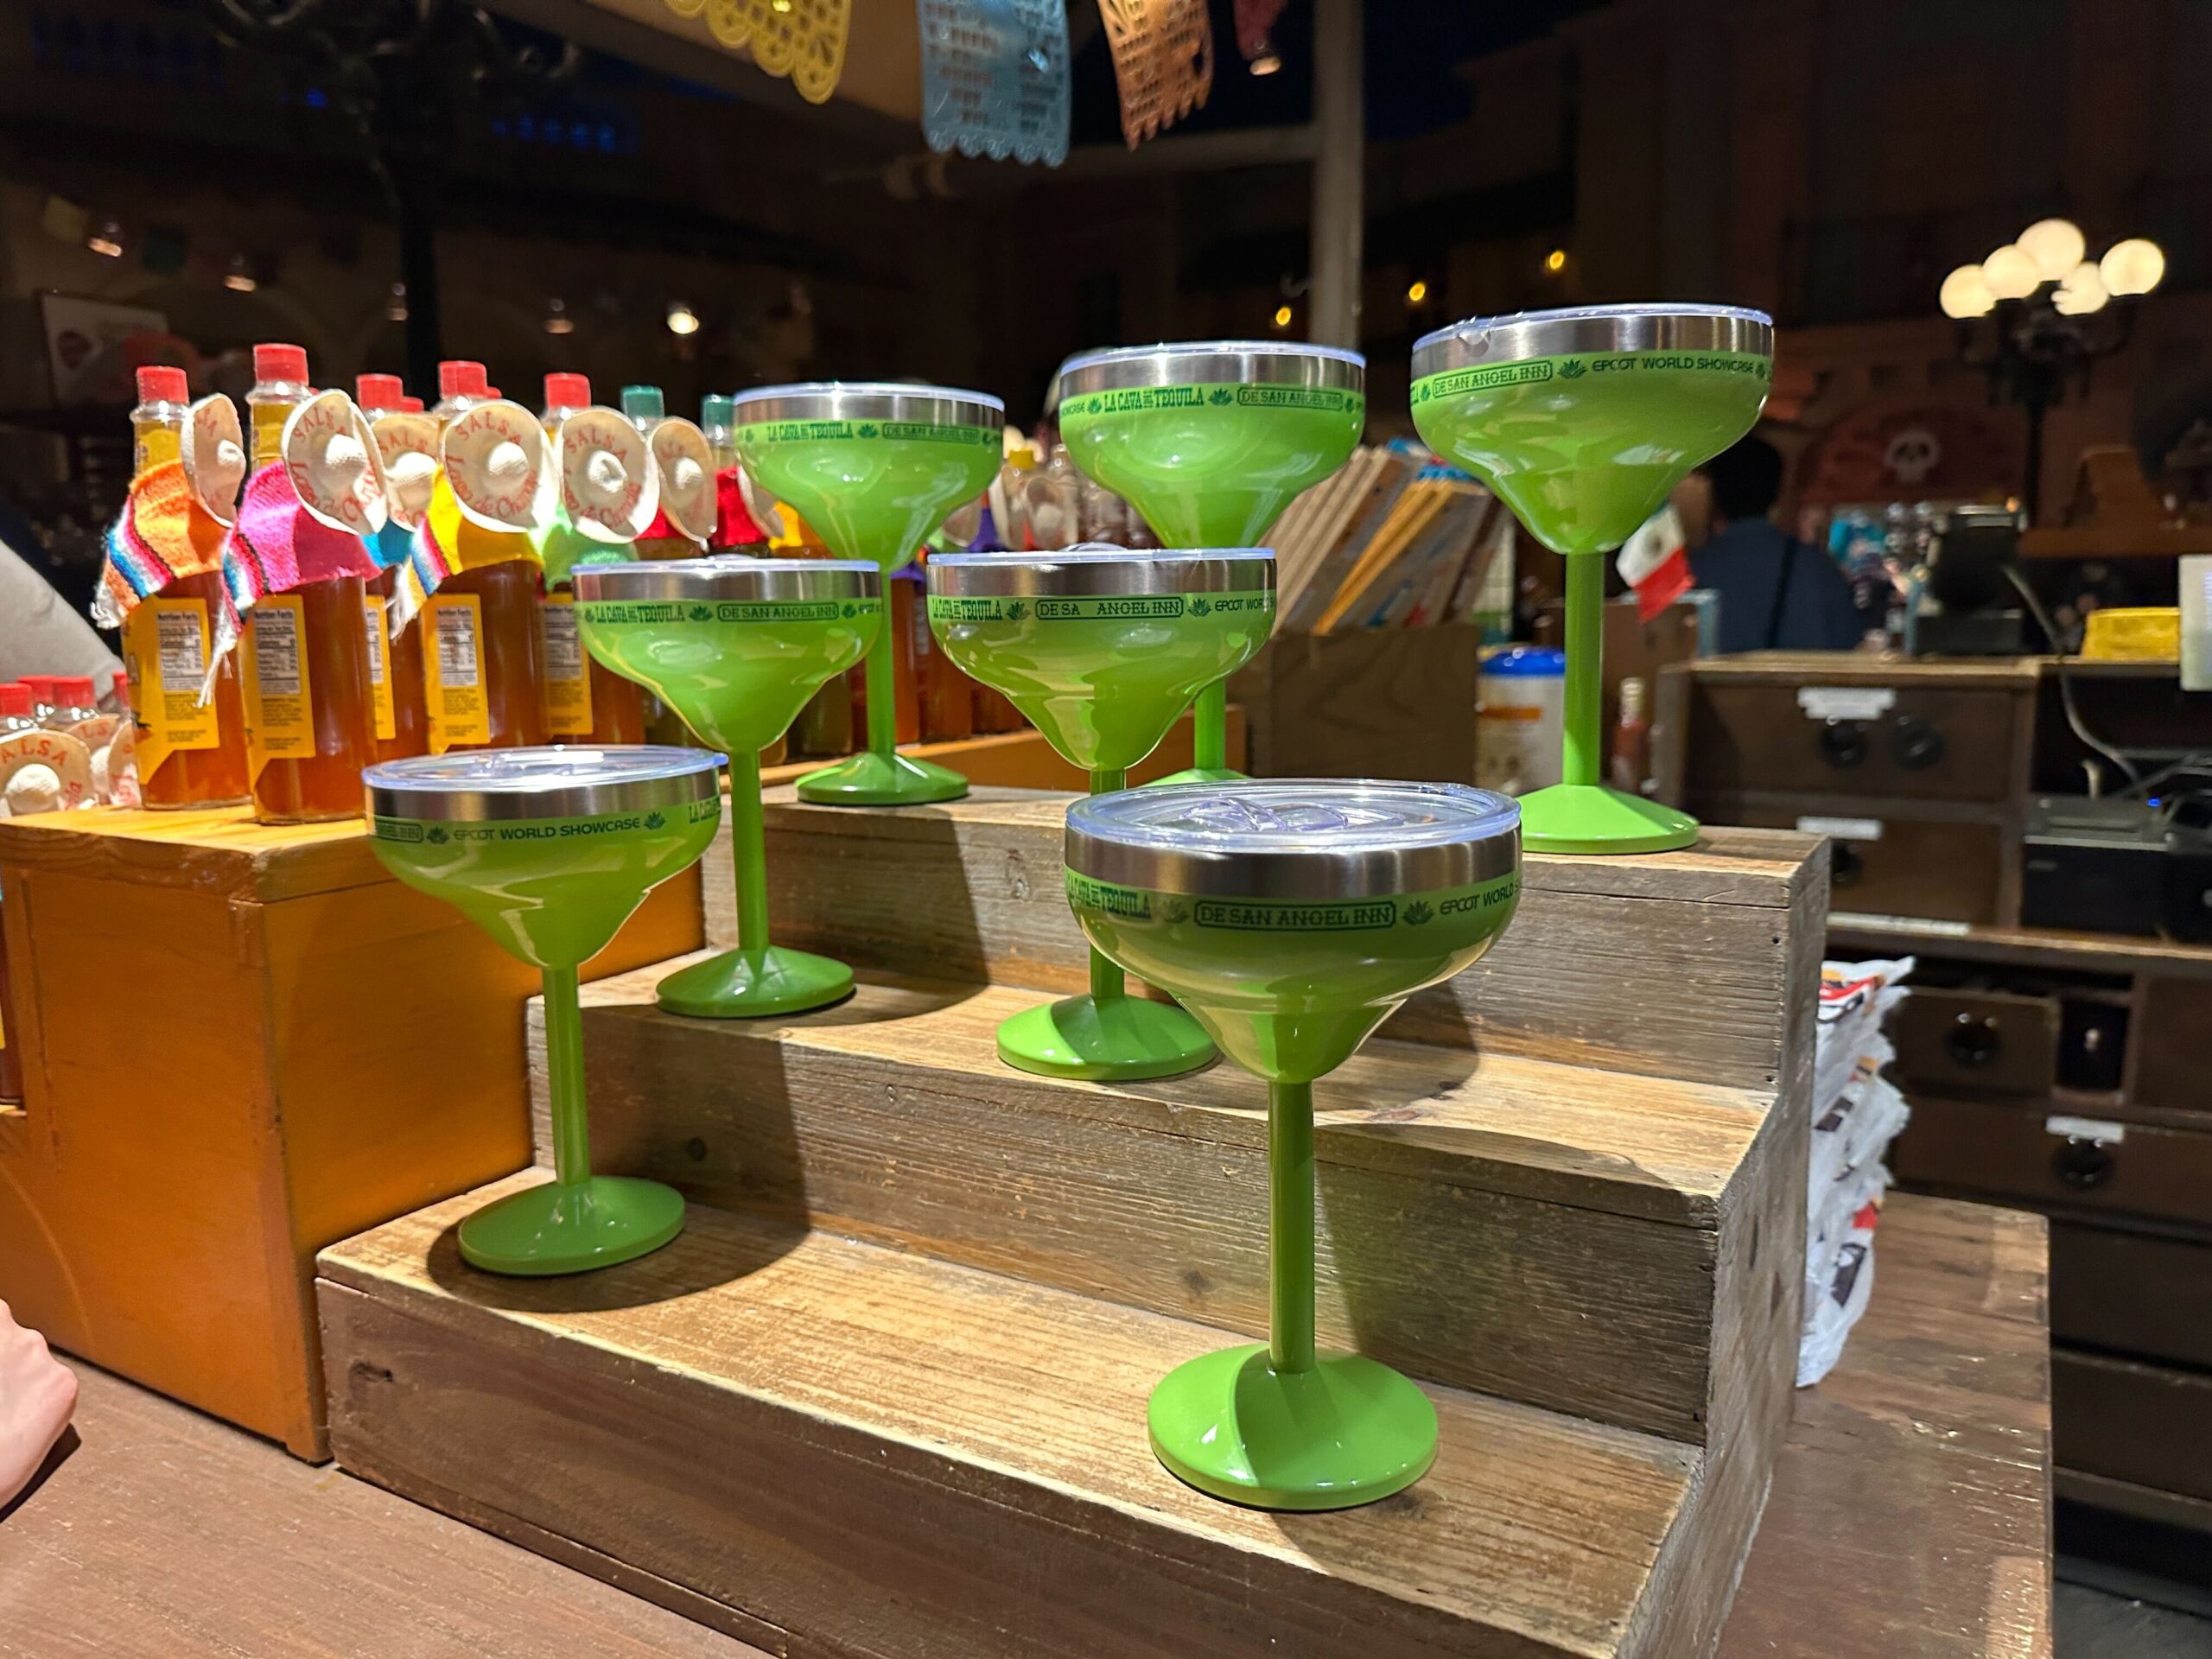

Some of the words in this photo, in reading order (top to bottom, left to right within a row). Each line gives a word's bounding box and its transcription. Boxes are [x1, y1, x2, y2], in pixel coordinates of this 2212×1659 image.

[1592, 358, 1637, 372] EPCOT
[1642, 357, 1694, 370] WORLD
[1697, 358, 1754, 374] SHOWCASE
[1435, 381, 1446, 395] DE
[1448, 376, 1470, 392] SAN
[1520, 365, 1548, 380] INN
[1104, 395, 1116, 412] LA
[1118, 392, 1142, 411] CAVA
[1154, 387, 1205, 409] TEQUILA
[1242, 392, 1258, 403] DE
[1260, 392, 1286, 404] SAN
[454, 410, 522, 446] SALSA
[376, 430, 429, 454] SALS
[566, 428, 628, 461] SALSA
[637, 605, 686, 623] TEQUILA
[721, 607, 740, 619] DE
[741, 607, 770, 619] SAN
[961, 600, 1003, 621] TEQUILA
[1039, 604, 1058, 616] DE
[1096, 601, 1150, 615] ANGEL
[1153, 601, 1179, 614] INN
[1215, 599, 1243, 612] EPCOT
[0, 738, 67, 767] ALSA
[454, 829, 495, 840] EPCOT
[499, 826, 556, 841] WORLD
[560, 817, 640, 837] SHOWCASE
[1440, 894, 1480, 915] EPCOT
[1483, 882, 1514, 907] WORLD
[1201, 907, 1225, 923] DE
[1230, 908, 1271, 925] SAN
[1276, 909, 1349, 925] ANGEL
[1353, 907, 1390, 924] INN
